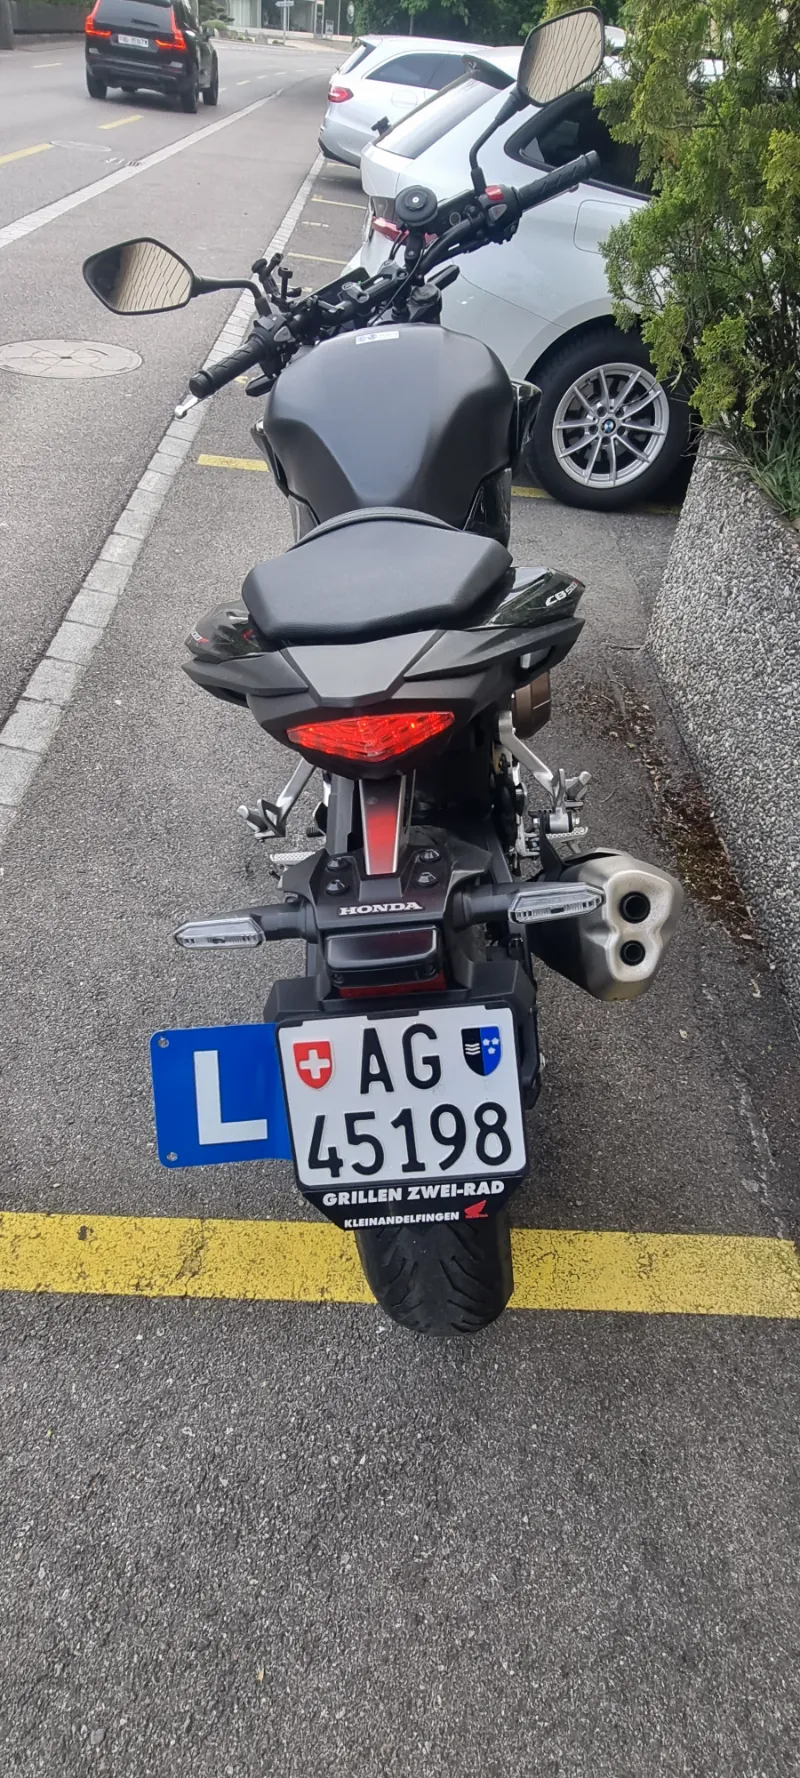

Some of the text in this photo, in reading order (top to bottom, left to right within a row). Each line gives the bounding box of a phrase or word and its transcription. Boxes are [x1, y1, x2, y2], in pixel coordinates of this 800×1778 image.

[339, 901, 423, 916] HONDA
[359, 1023, 442, 1095] AG
[193, 1049, 268, 1145] L
[308, 1101, 512, 1178] 45198
[322, 1180, 505, 1206] GRILLEN ZWEI-RAD
[344, 1211, 460, 1229] KLEINANDELFINGEN
